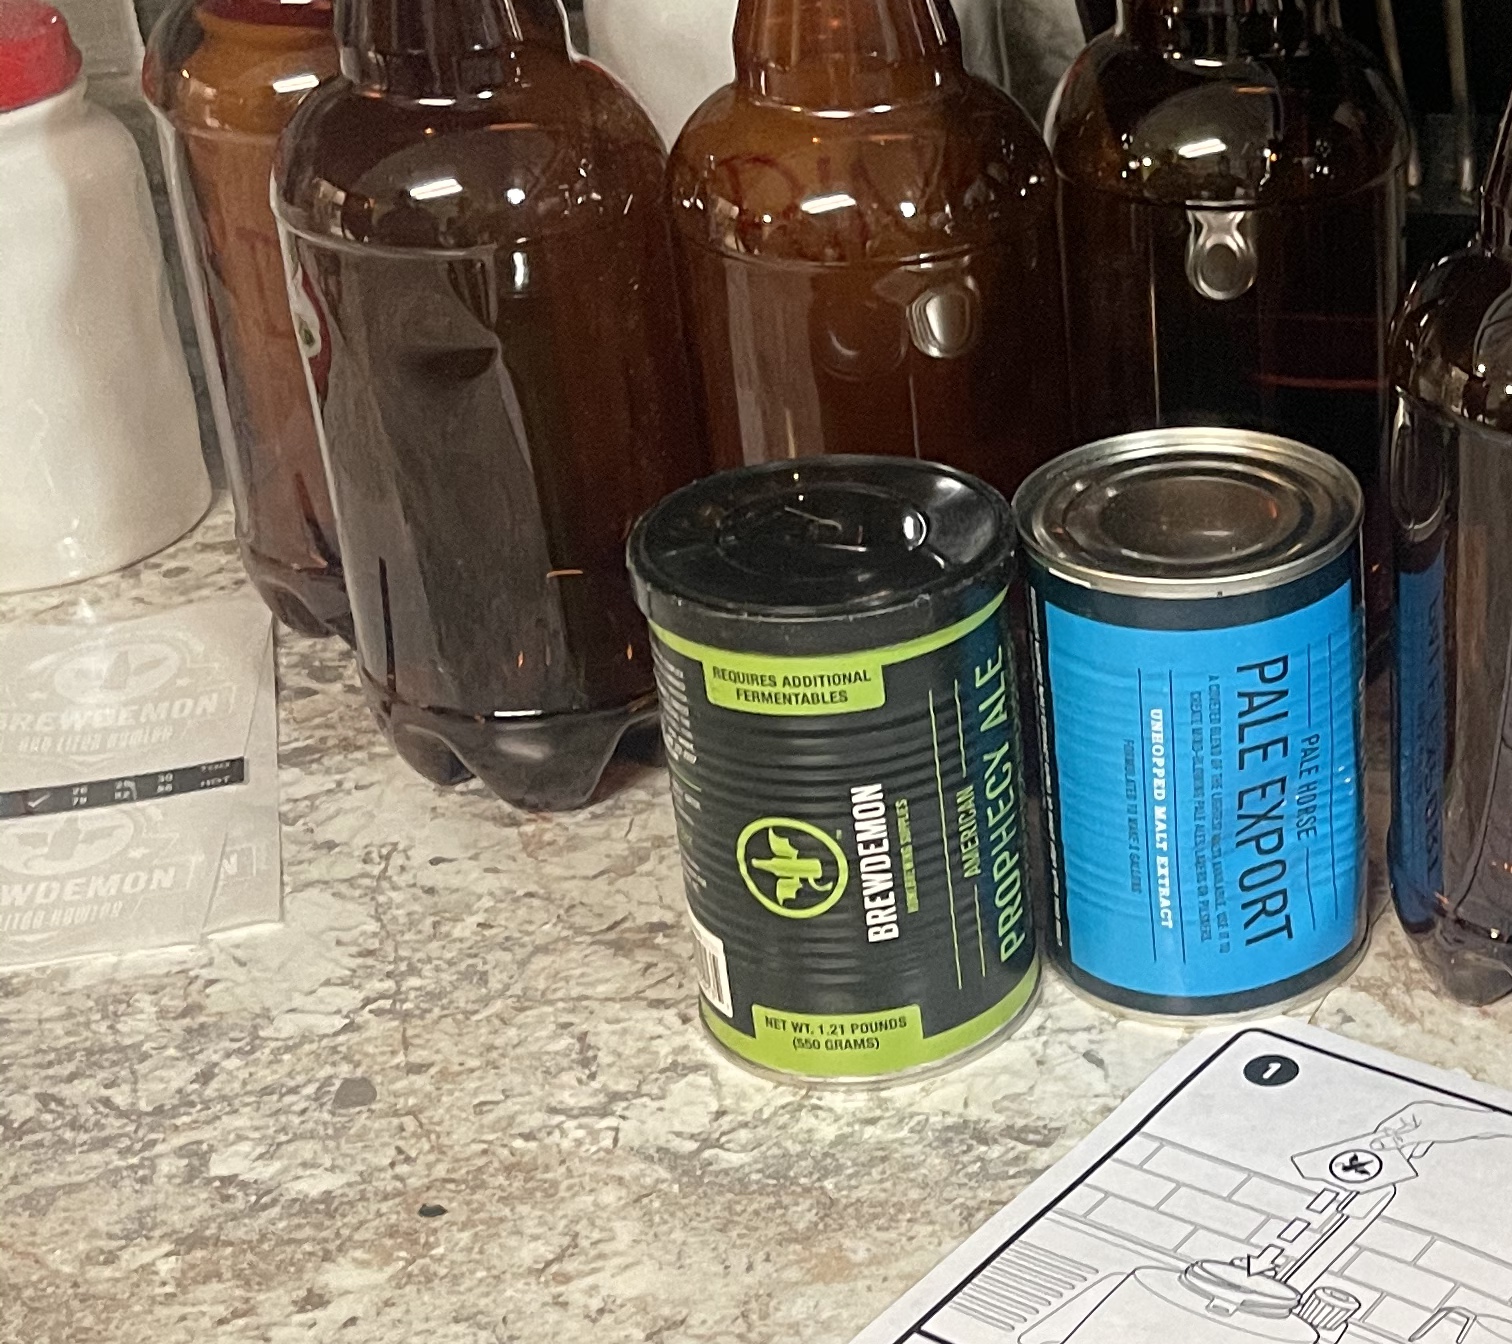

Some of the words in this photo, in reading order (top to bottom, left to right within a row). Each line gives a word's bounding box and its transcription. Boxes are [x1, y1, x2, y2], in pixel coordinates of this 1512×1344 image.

[713, 666, 778, 688] REQUIRES
[782, 669, 871, 687] ADDITIONAL
[736, 688, 848, 705] FERMENTABLES
[974, 645, 1008, 732] ALE
[1237, 654, 1288, 770] PALE
[1150, 708, 1165, 800] UNHOPPED
[1299, 733, 1320, 779] PALE
[956, 785, 981, 878] AMERICAN
[1154, 806, 1167, 851] MALT
[1296, 784, 1317, 840] HORSE
[851, 784, 900, 942] BREWDEMON
[983, 742, 1026, 962] PROPHECY
[1236, 776, 1293, 947] EXPORT
[1156, 856, 1173, 928] EXTRACT
[764, 1015, 789, 1031] NET
[791, 1020, 815, 1035] WT.
[817, 1023, 846, 1036] 1.21
[850, 1014, 907, 1034] POUNDS
[793, 1037, 820, 1051] (550
[825, 1036, 880, 1051] GRAMS)
[1262, 1062, 1282, 1080] 1
